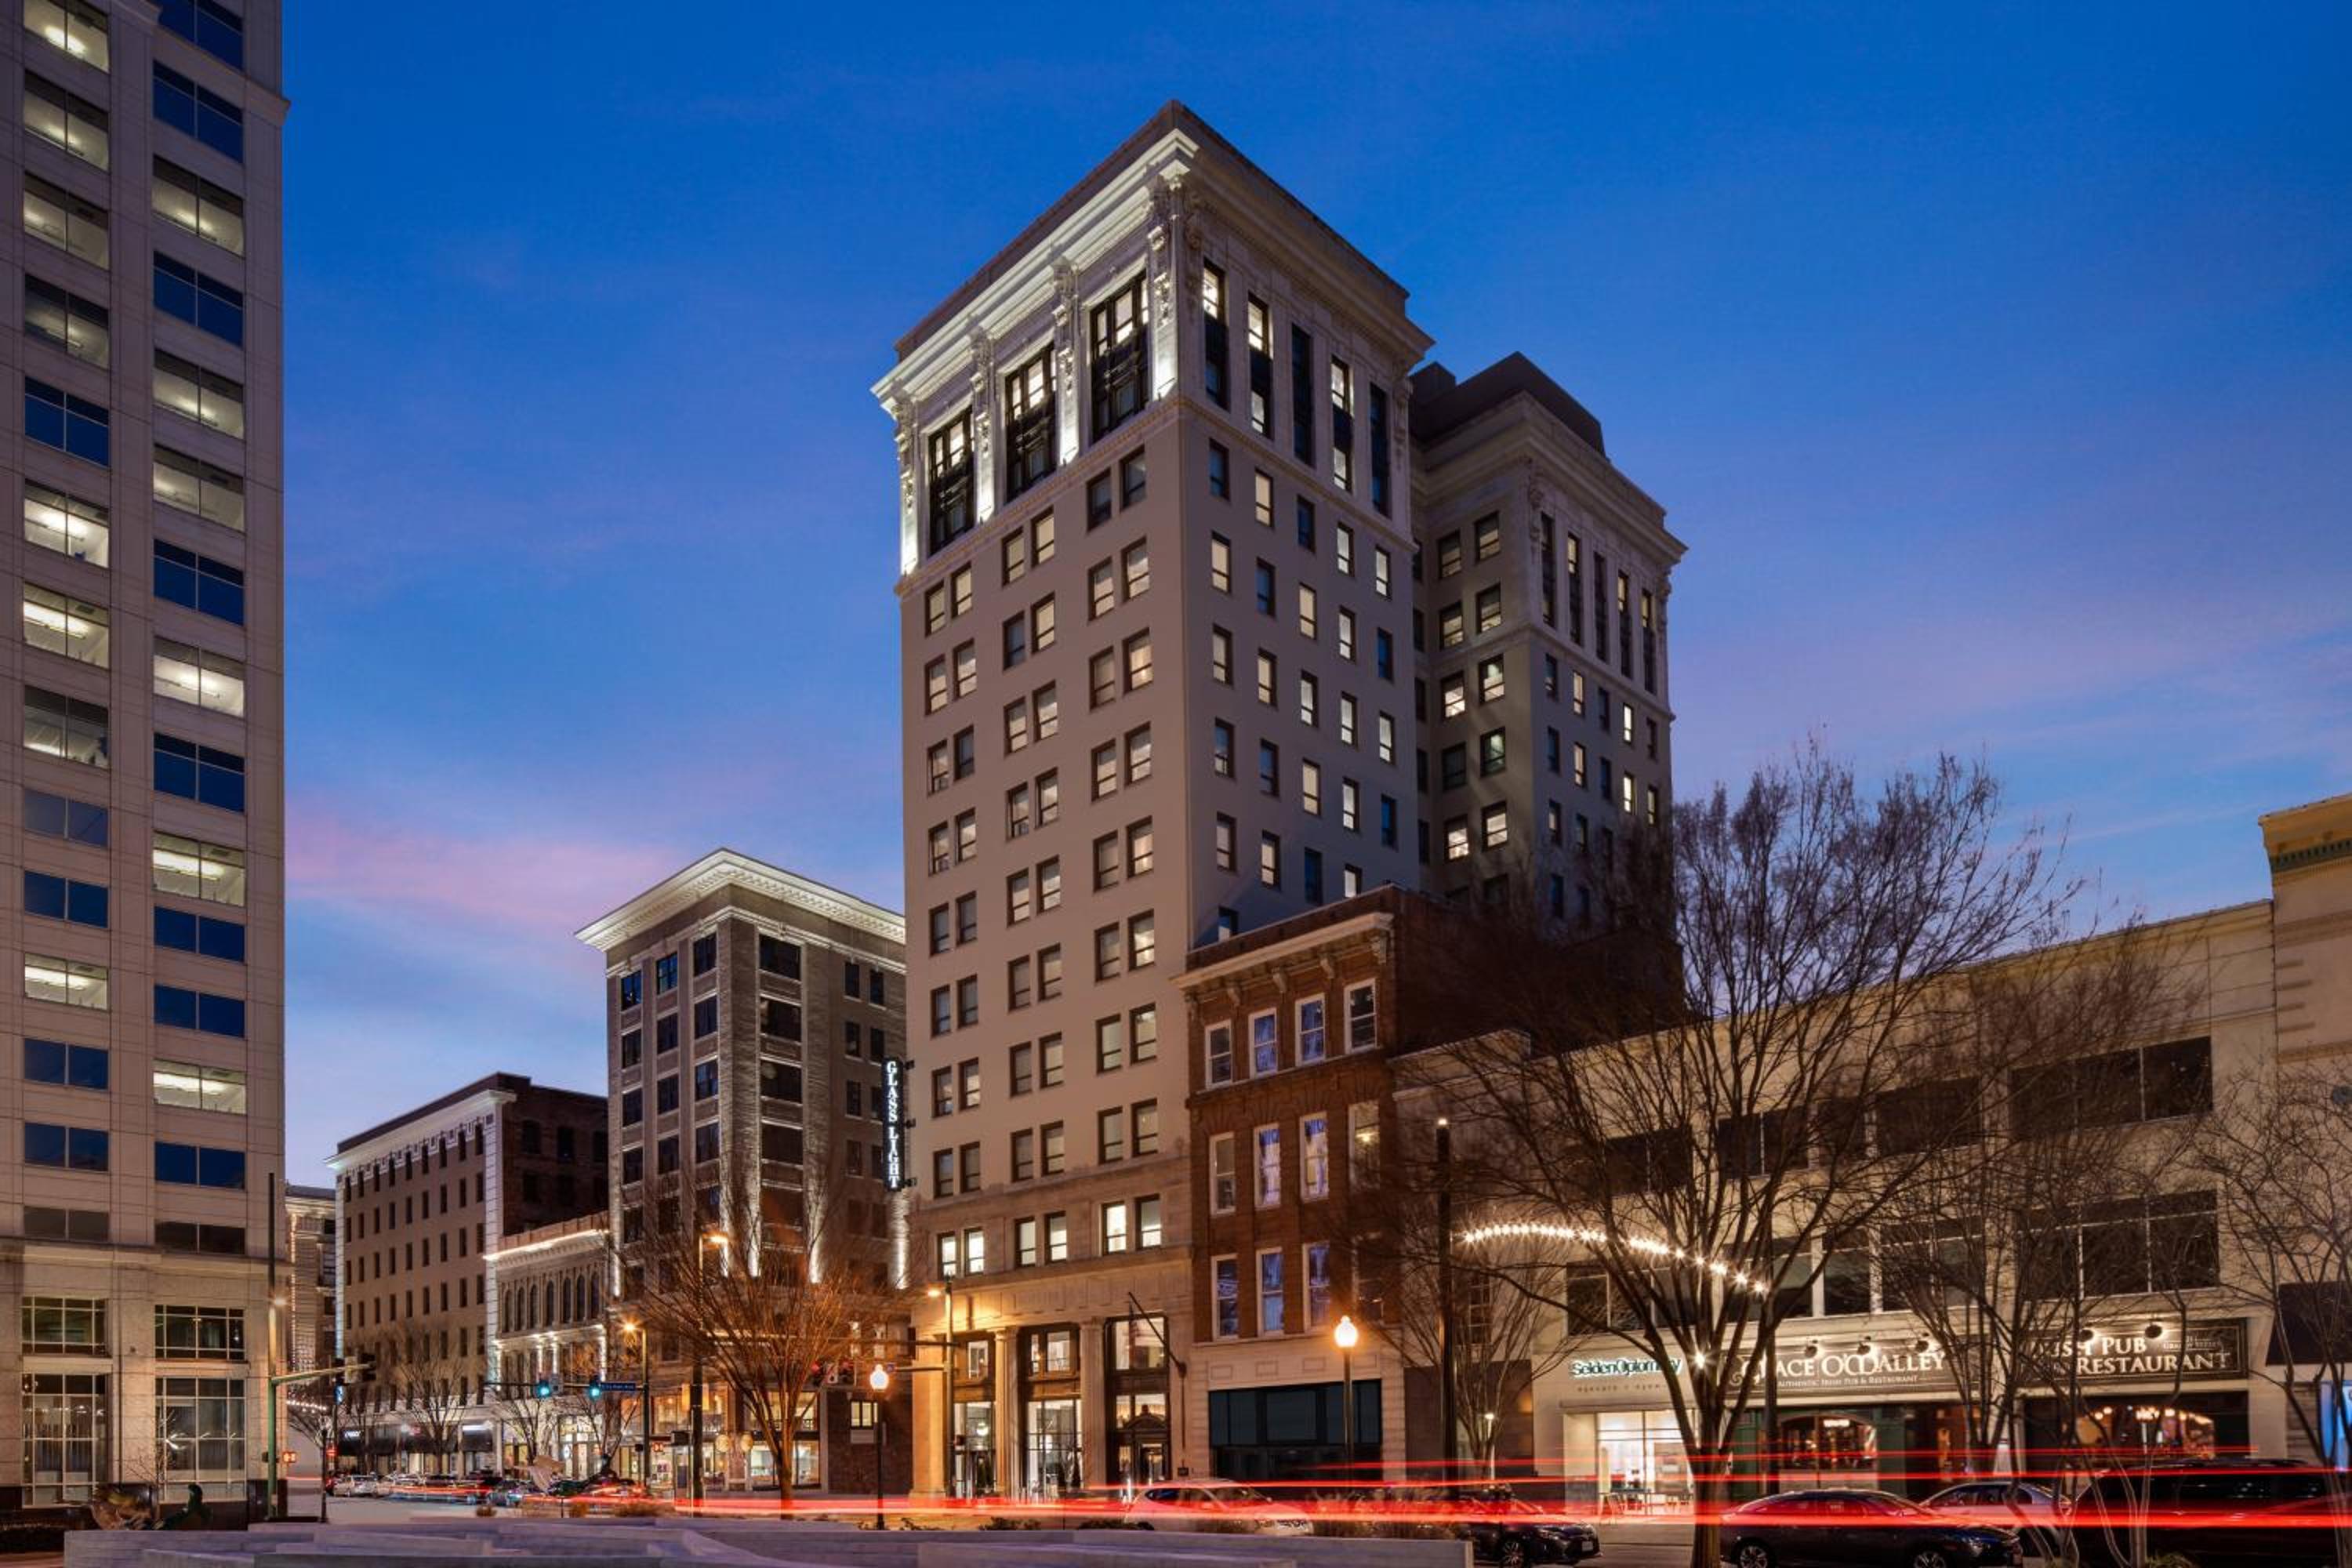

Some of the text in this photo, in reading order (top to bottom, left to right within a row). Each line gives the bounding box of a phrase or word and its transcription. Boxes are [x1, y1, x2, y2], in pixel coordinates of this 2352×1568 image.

[887, 1061, 899, 1188] GLASS LIGHT
[2101, 1337, 2147, 1355] PUB
[2077, 1352, 2230, 1373] RESTAURANT
